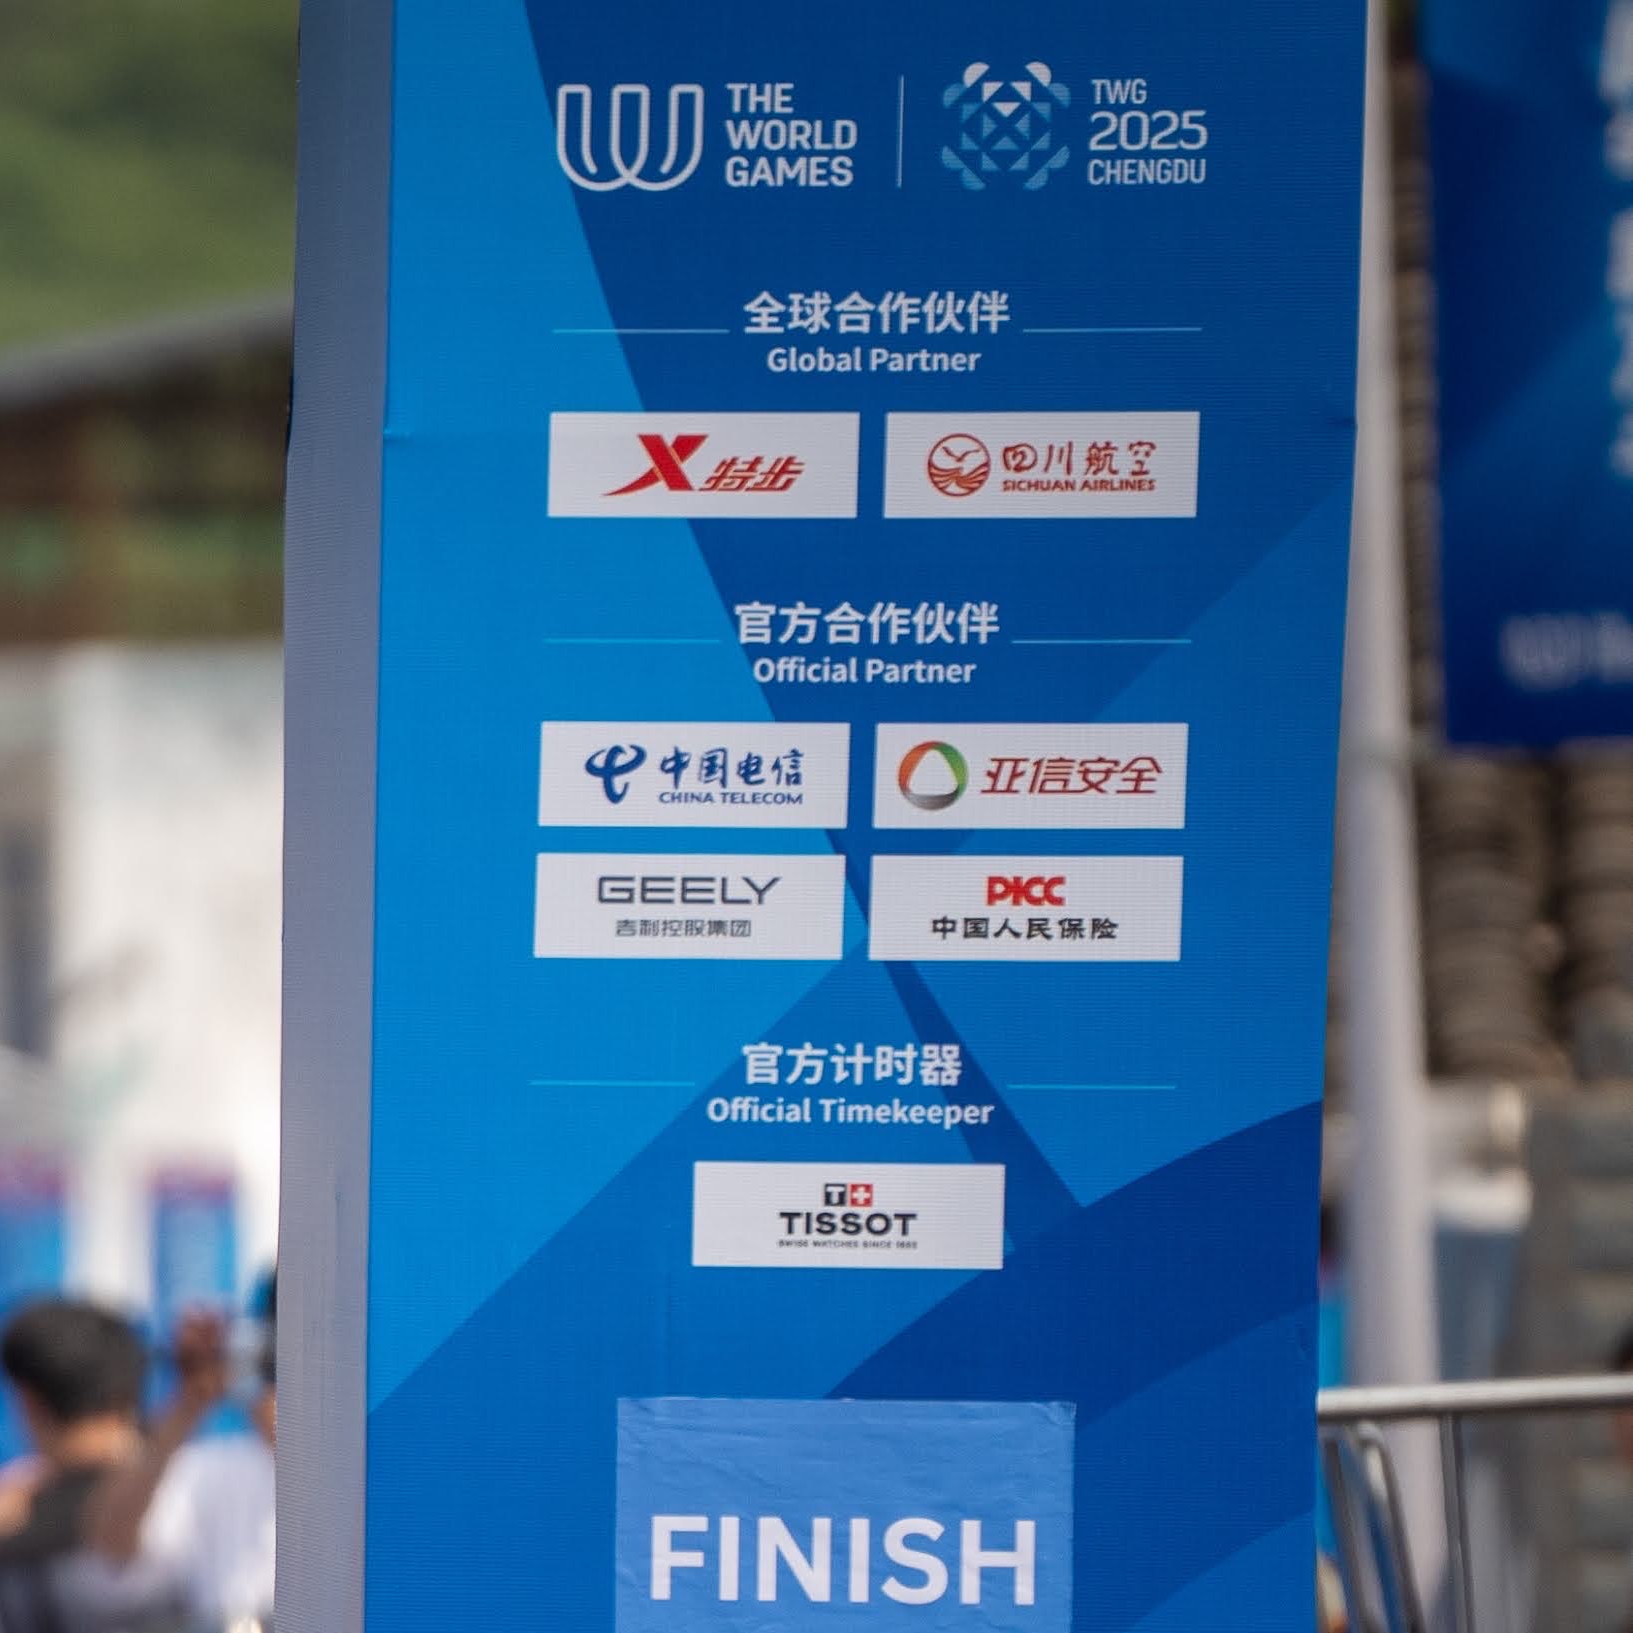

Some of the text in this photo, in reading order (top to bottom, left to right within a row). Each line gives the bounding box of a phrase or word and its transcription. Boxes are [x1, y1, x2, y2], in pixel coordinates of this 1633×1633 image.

[726, 83, 794, 114] THE
[1092, 79, 1148, 104] TWG
[726, 120, 857, 151] WORLD
[1088, 111, 1209, 152] 2025
[725, 157, 854, 187] GAMES
[1087, 158, 1207, 186] CHENGDU
[743, 291, 1011, 336] 全球合作伙伴
[766, 347, 982, 374] Global Partner
[1002, 440, 1157, 475] 四川航空
[700, 456, 806, 493] 特步
[1002, 479, 1156, 492] SICHUAN AIRLINES
[735, 602, 1000, 646] 官方合作伙伴
[752, 656, 977, 685] Official Partner
[658, 747, 805, 789] 中国电信
[981, 756, 1164, 797] 亚信安全
[658, 791, 804, 805] CHINA TELECOM
[597, 875, 781, 905] GEELY
[986, 875, 1066, 906] PICC
[615, 919, 752, 938] 吉利控股集团
[931, 916, 1119, 941] 中国人民保险
[741, 1042, 962, 1087] 官方计时器
[706, 1097, 995, 1130] Official Timekeeper
[779, 1211, 918, 1236] TISSOT
[650, 1515, 1037, 1606] FINISH
